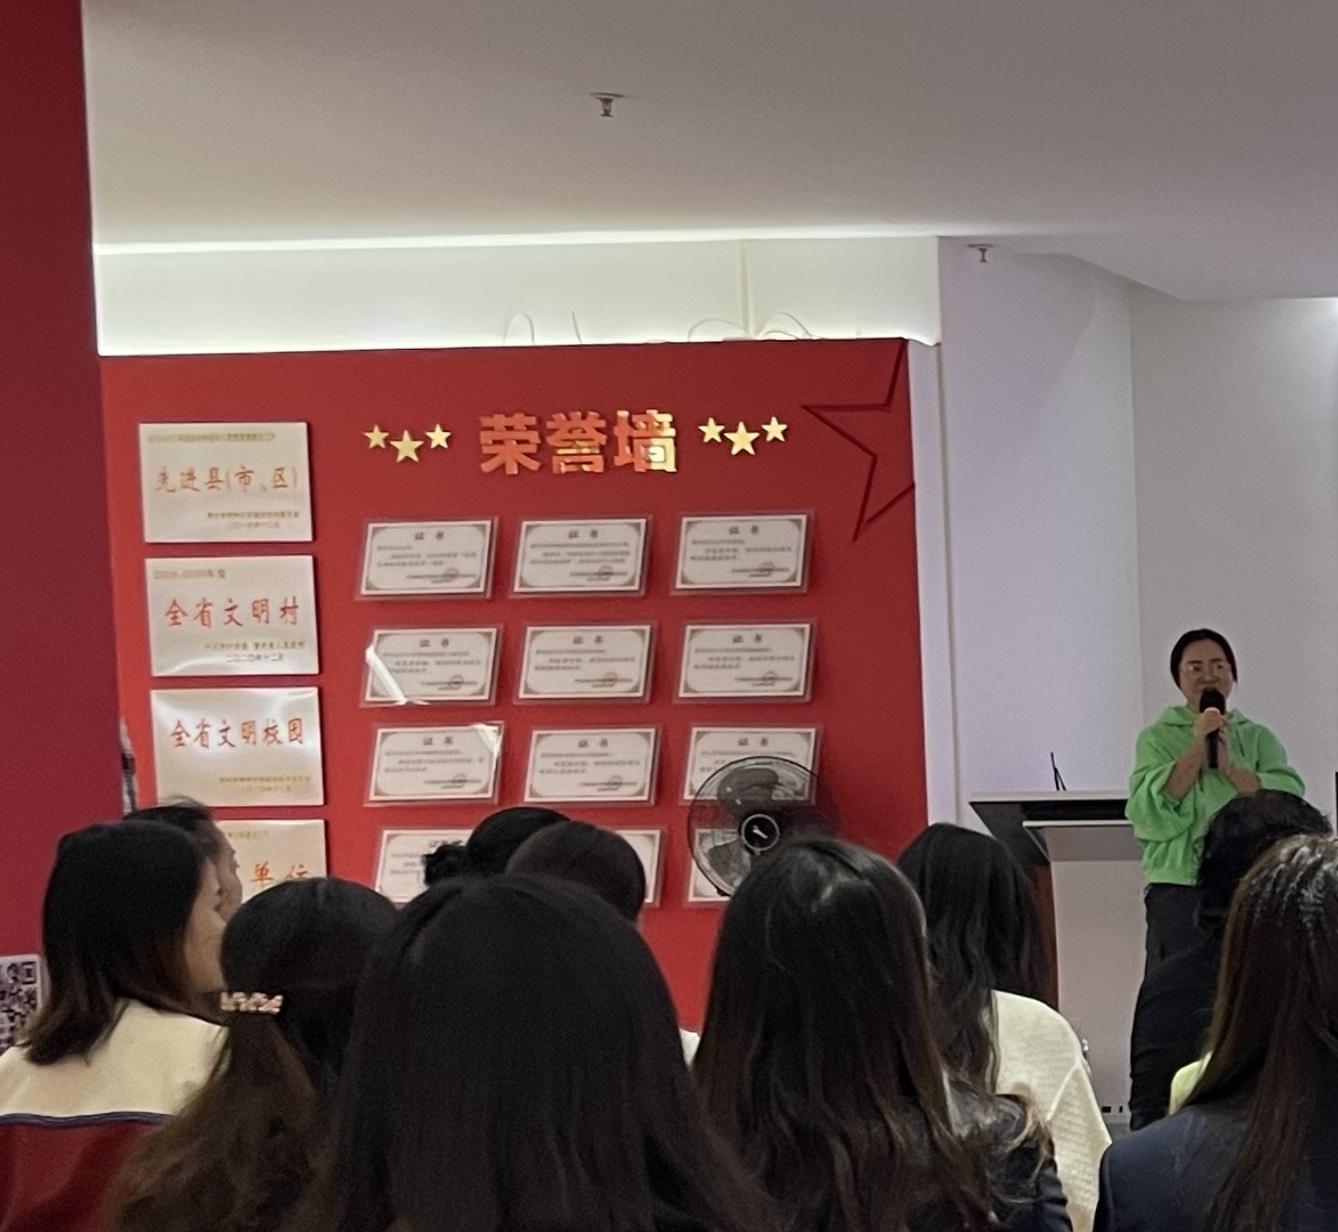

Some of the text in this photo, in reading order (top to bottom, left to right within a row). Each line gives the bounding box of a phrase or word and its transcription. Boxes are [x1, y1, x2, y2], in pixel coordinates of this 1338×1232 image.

[478, 410, 679, 475] 荣誉墙
[165, 596, 299, 628] 全省文明村
[170, 718, 304, 749] 全省文明校园
